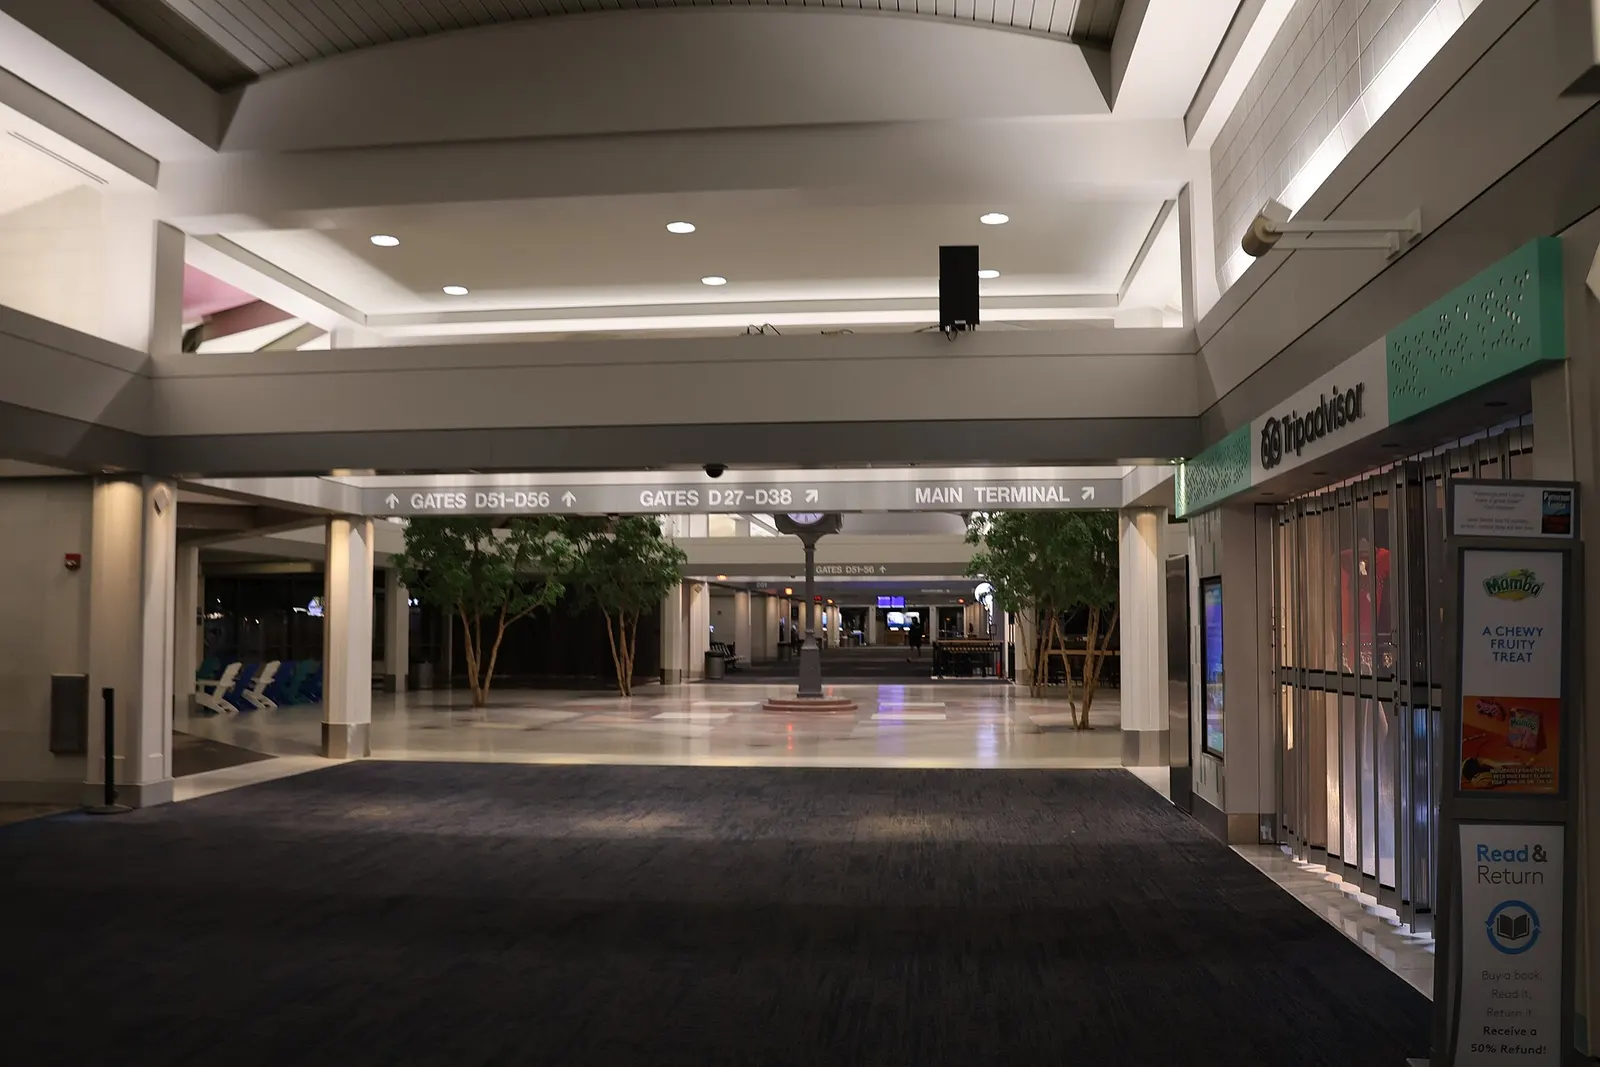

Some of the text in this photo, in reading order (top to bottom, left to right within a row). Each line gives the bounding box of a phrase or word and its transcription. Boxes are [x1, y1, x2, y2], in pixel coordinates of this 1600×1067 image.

[1281, 382, 1364, 457] Tripadvisor
[411, 492, 550, 509] GATES D51-D56
[639, 489, 793, 507] GATES D27-D38
[915, 486, 1070, 503] MAIN TERMINAL
[815, 565, 842, 574] GATES
[1484, 575, 1543, 597] Mamba
[1482, 626, 1544, 637] A CHEWY
[1490, 639, 1536, 650] FRUITY
[1492, 651, 1533, 662] TREAT
[1476, 844, 1548, 863] Read &
[1477, 865, 1544, 885] Return
[1481, 970, 1501, 983] Buy
[1504, 972, 1511, 981] a
[1491, 988, 1519, 999] Read
[1486, 1007, 1522, 1018] Return
[1483, 1026, 1537, 1037] Receive a
[1471, 1043, 1548, 1056] 50% Refund!
